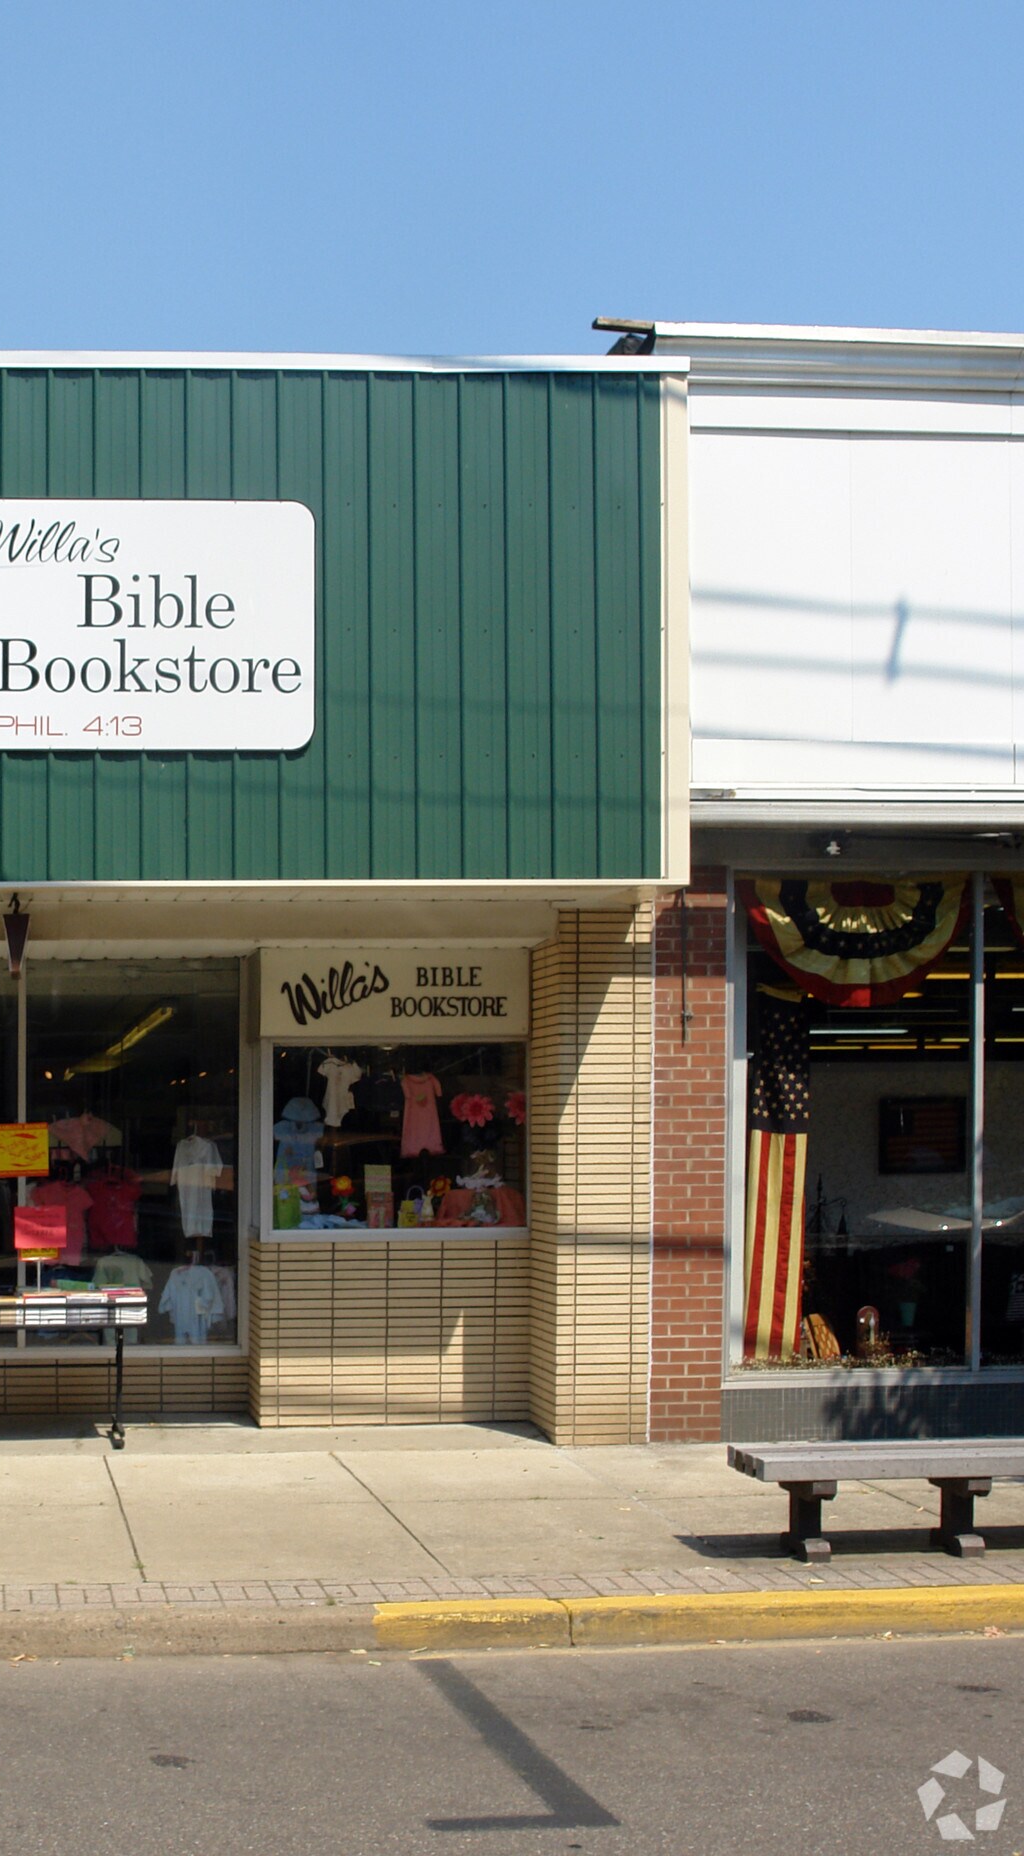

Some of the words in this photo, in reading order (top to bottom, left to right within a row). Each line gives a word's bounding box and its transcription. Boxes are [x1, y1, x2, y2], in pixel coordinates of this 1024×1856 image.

[77, 574, 236, 628] Bible
[82, 715, 143, 736] 4:13
[416, 967, 482, 986] BIBLE
[281, 961, 389, 1026] Willa's
[390, 997, 508, 1018] BOOKSTORE
